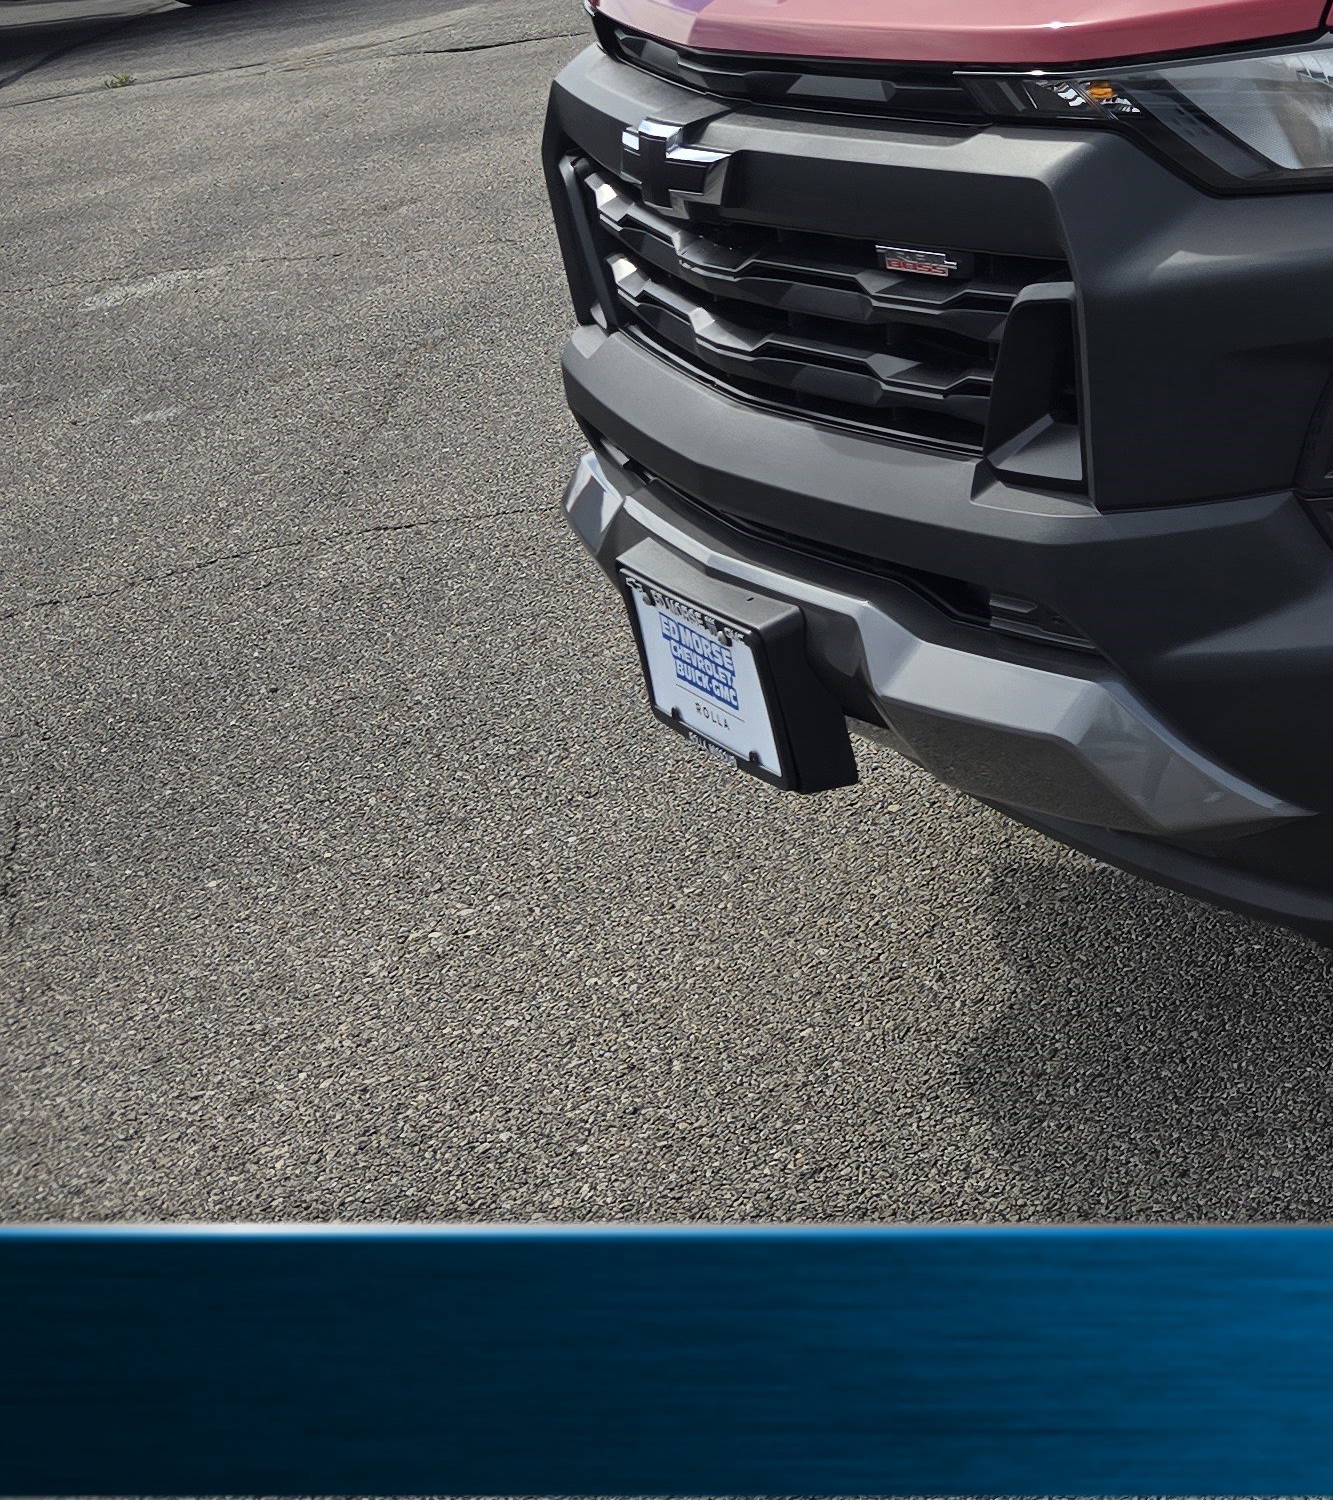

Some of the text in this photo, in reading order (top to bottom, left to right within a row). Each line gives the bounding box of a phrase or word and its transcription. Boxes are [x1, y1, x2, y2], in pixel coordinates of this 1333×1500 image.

[659, 615, 681, 642] ED
[678, 622, 735, 672] MORSE
[670, 639, 735, 687] CHEVROLET
[694, 701, 732, 732] ROLLA
